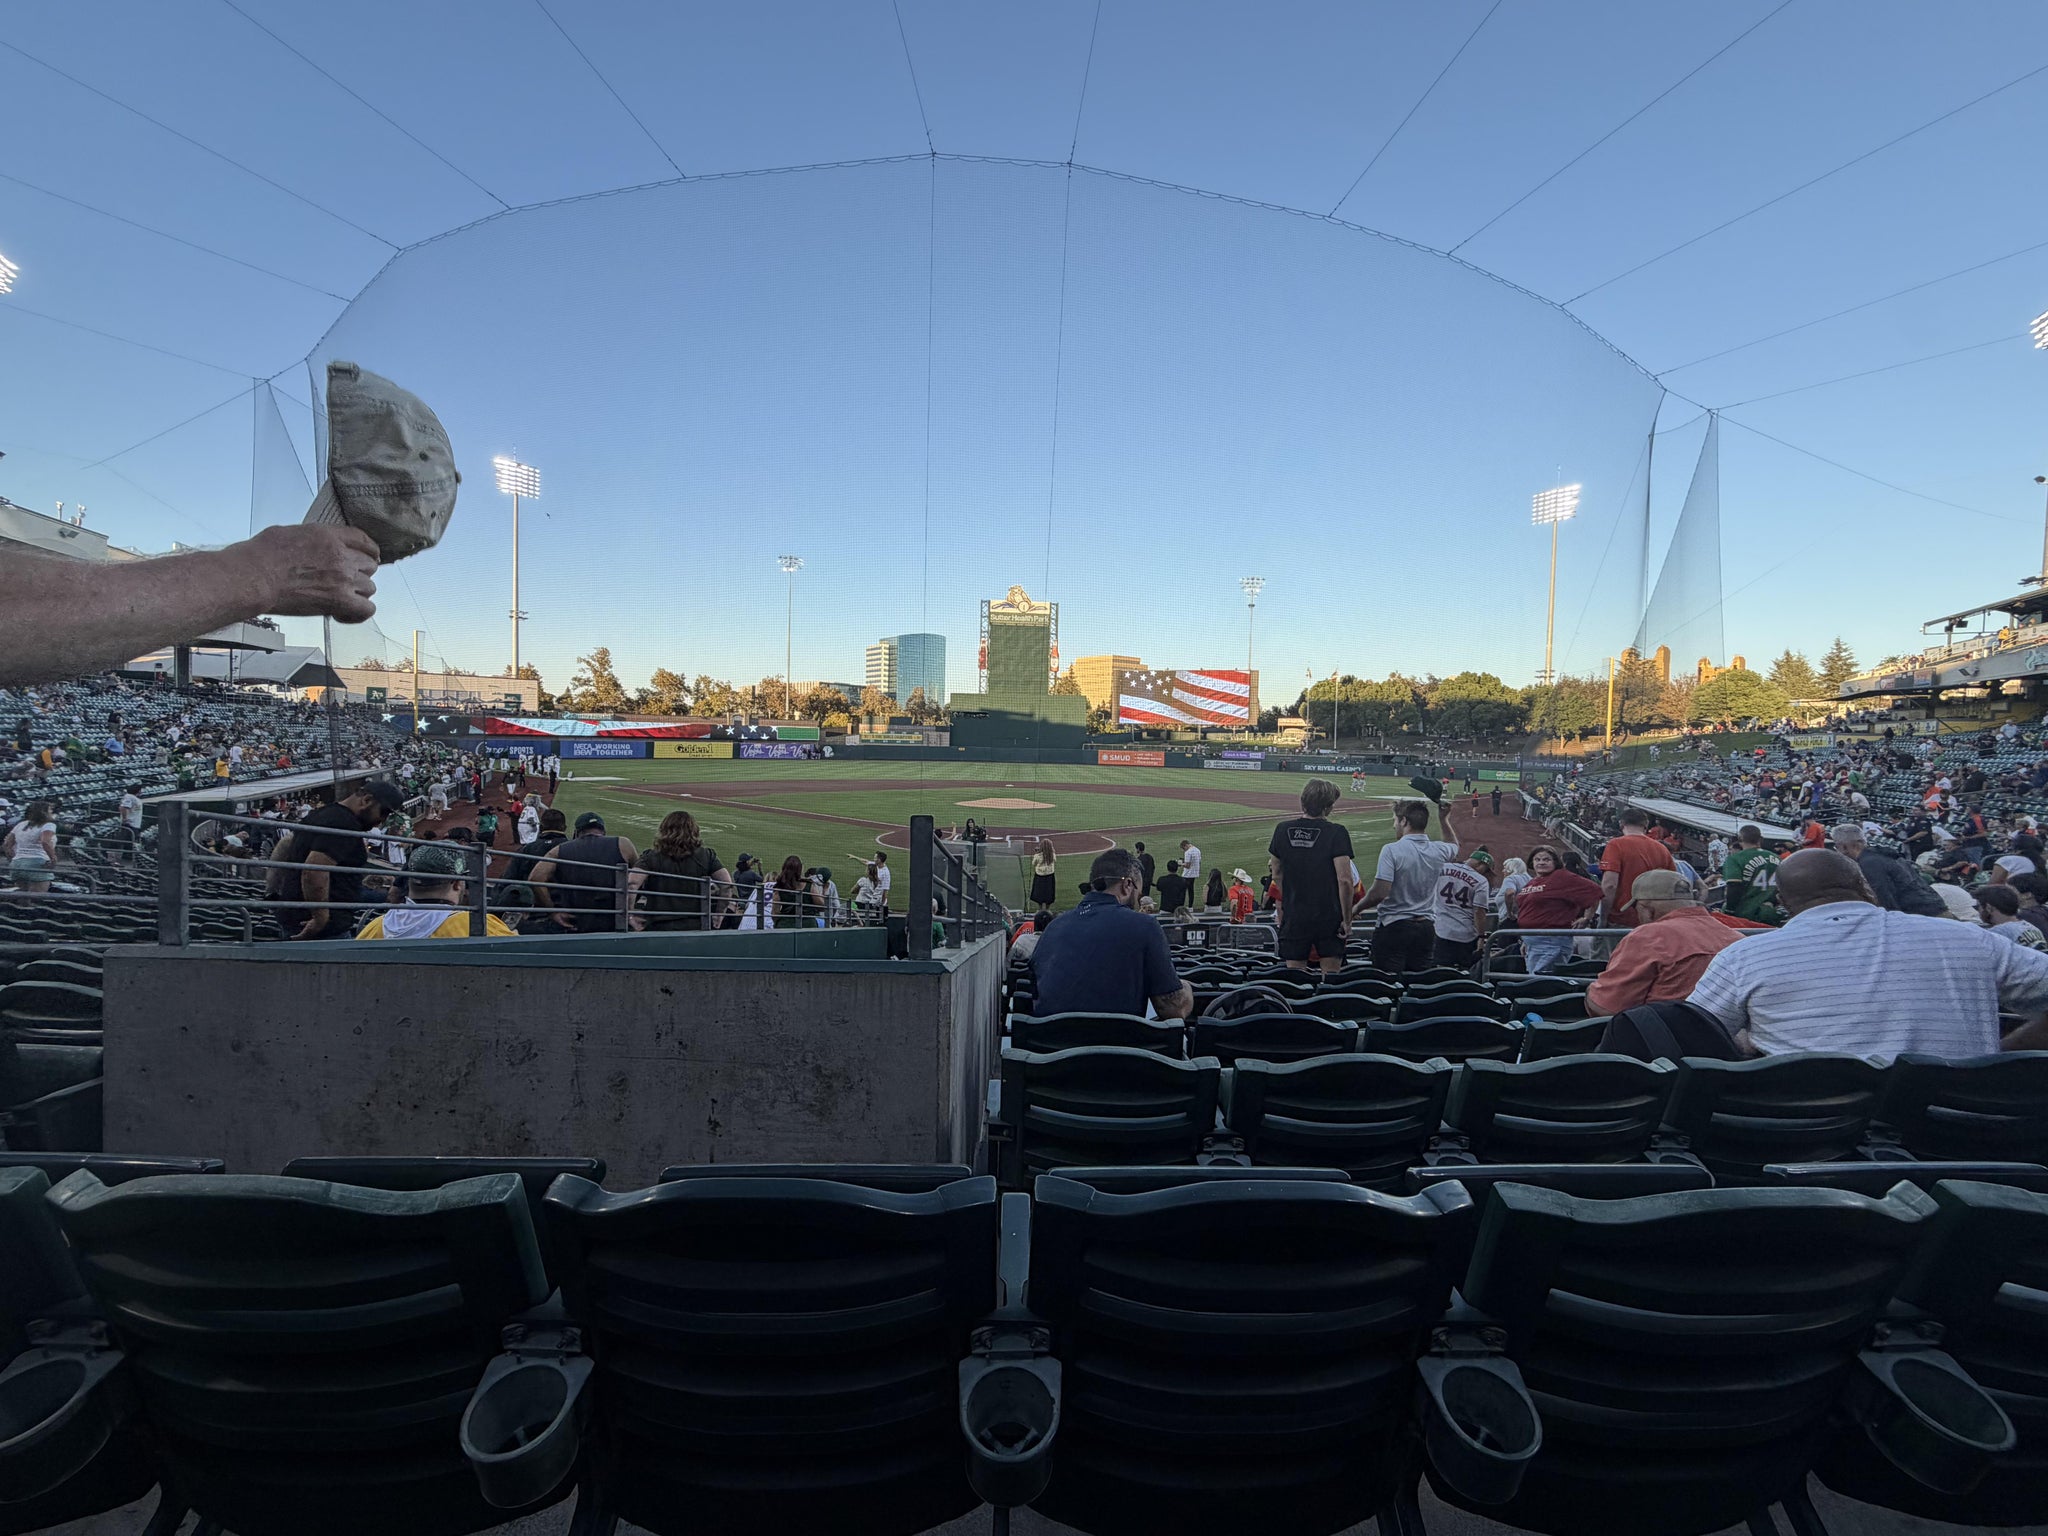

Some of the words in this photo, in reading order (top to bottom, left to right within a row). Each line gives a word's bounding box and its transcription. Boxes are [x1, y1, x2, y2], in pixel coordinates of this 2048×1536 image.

[1011, 614, 1033, 622] Health
[509, 746, 534, 755] SPORTS
[674, 744, 707, 753] Golden
[1440, 881, 1470, 908] 44
